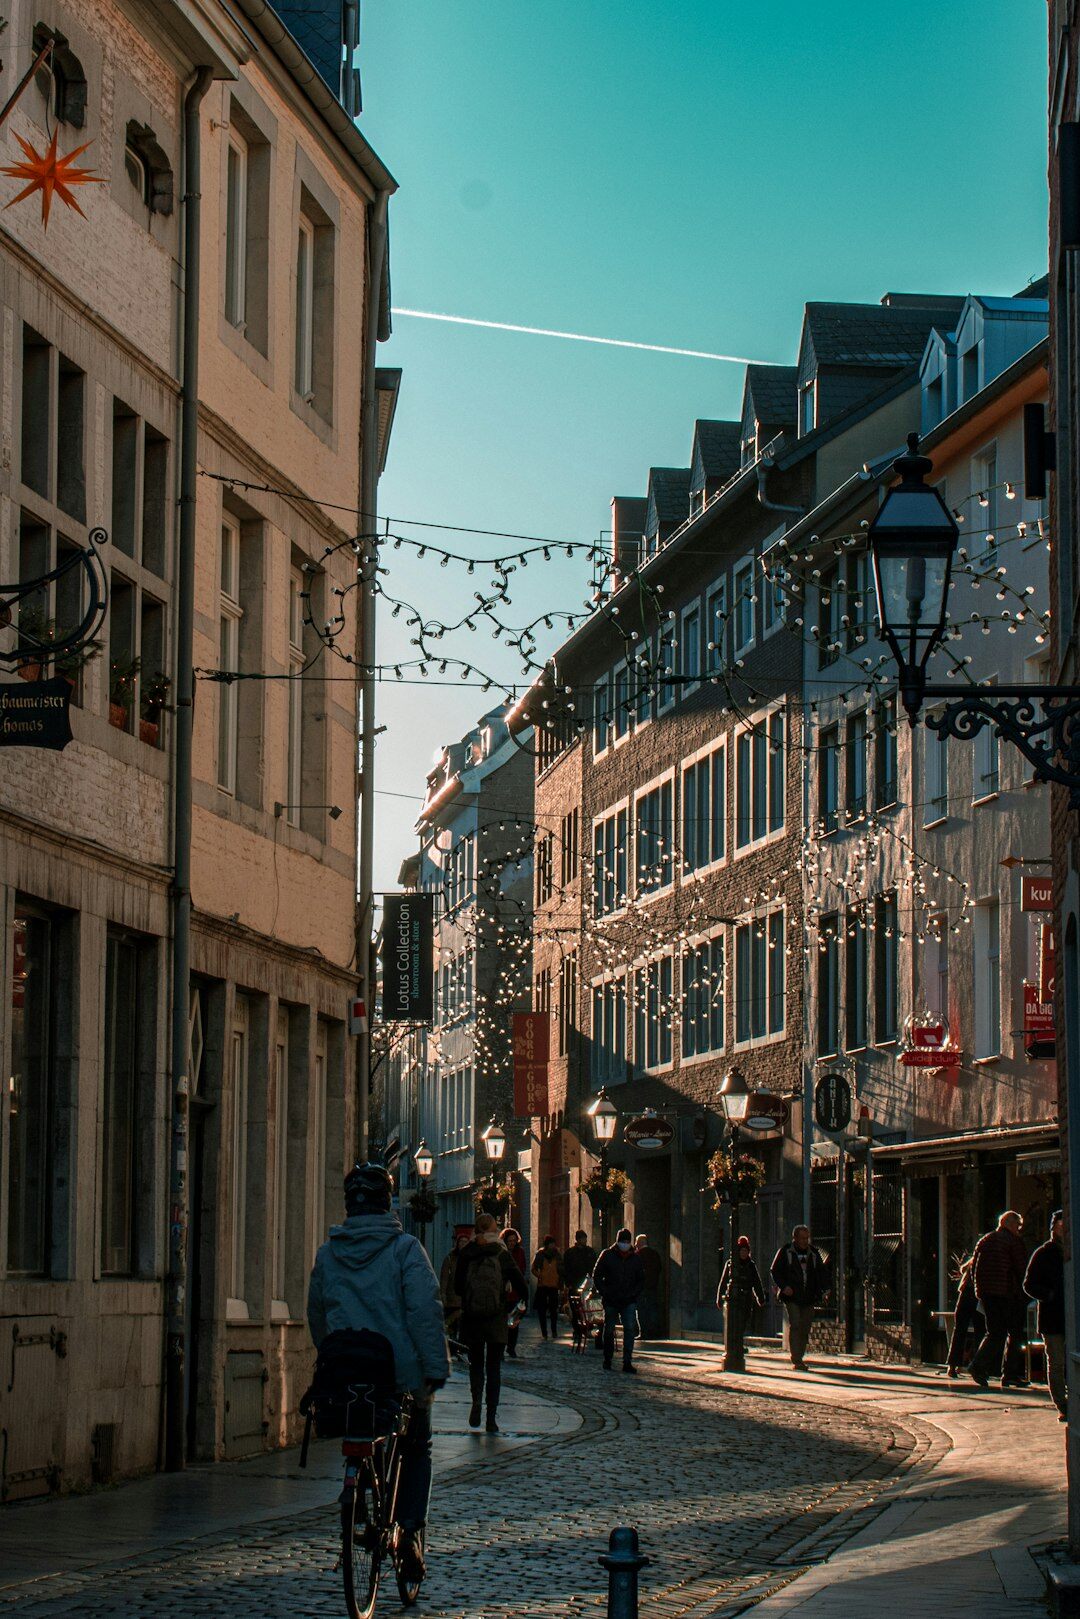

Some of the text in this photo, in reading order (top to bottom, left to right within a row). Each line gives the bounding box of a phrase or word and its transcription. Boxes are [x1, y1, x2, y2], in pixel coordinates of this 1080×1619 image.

[0, 717, 43, 734] homas
[397, 903, 410, 1011] Lotus Collection
[411, 921, 419, 998] showroom & store
[1026, 1003, 1038, 1015] DA
[525, 1018, 535, 1060] GORG
[526, 1070, 536, 1113] GORG
